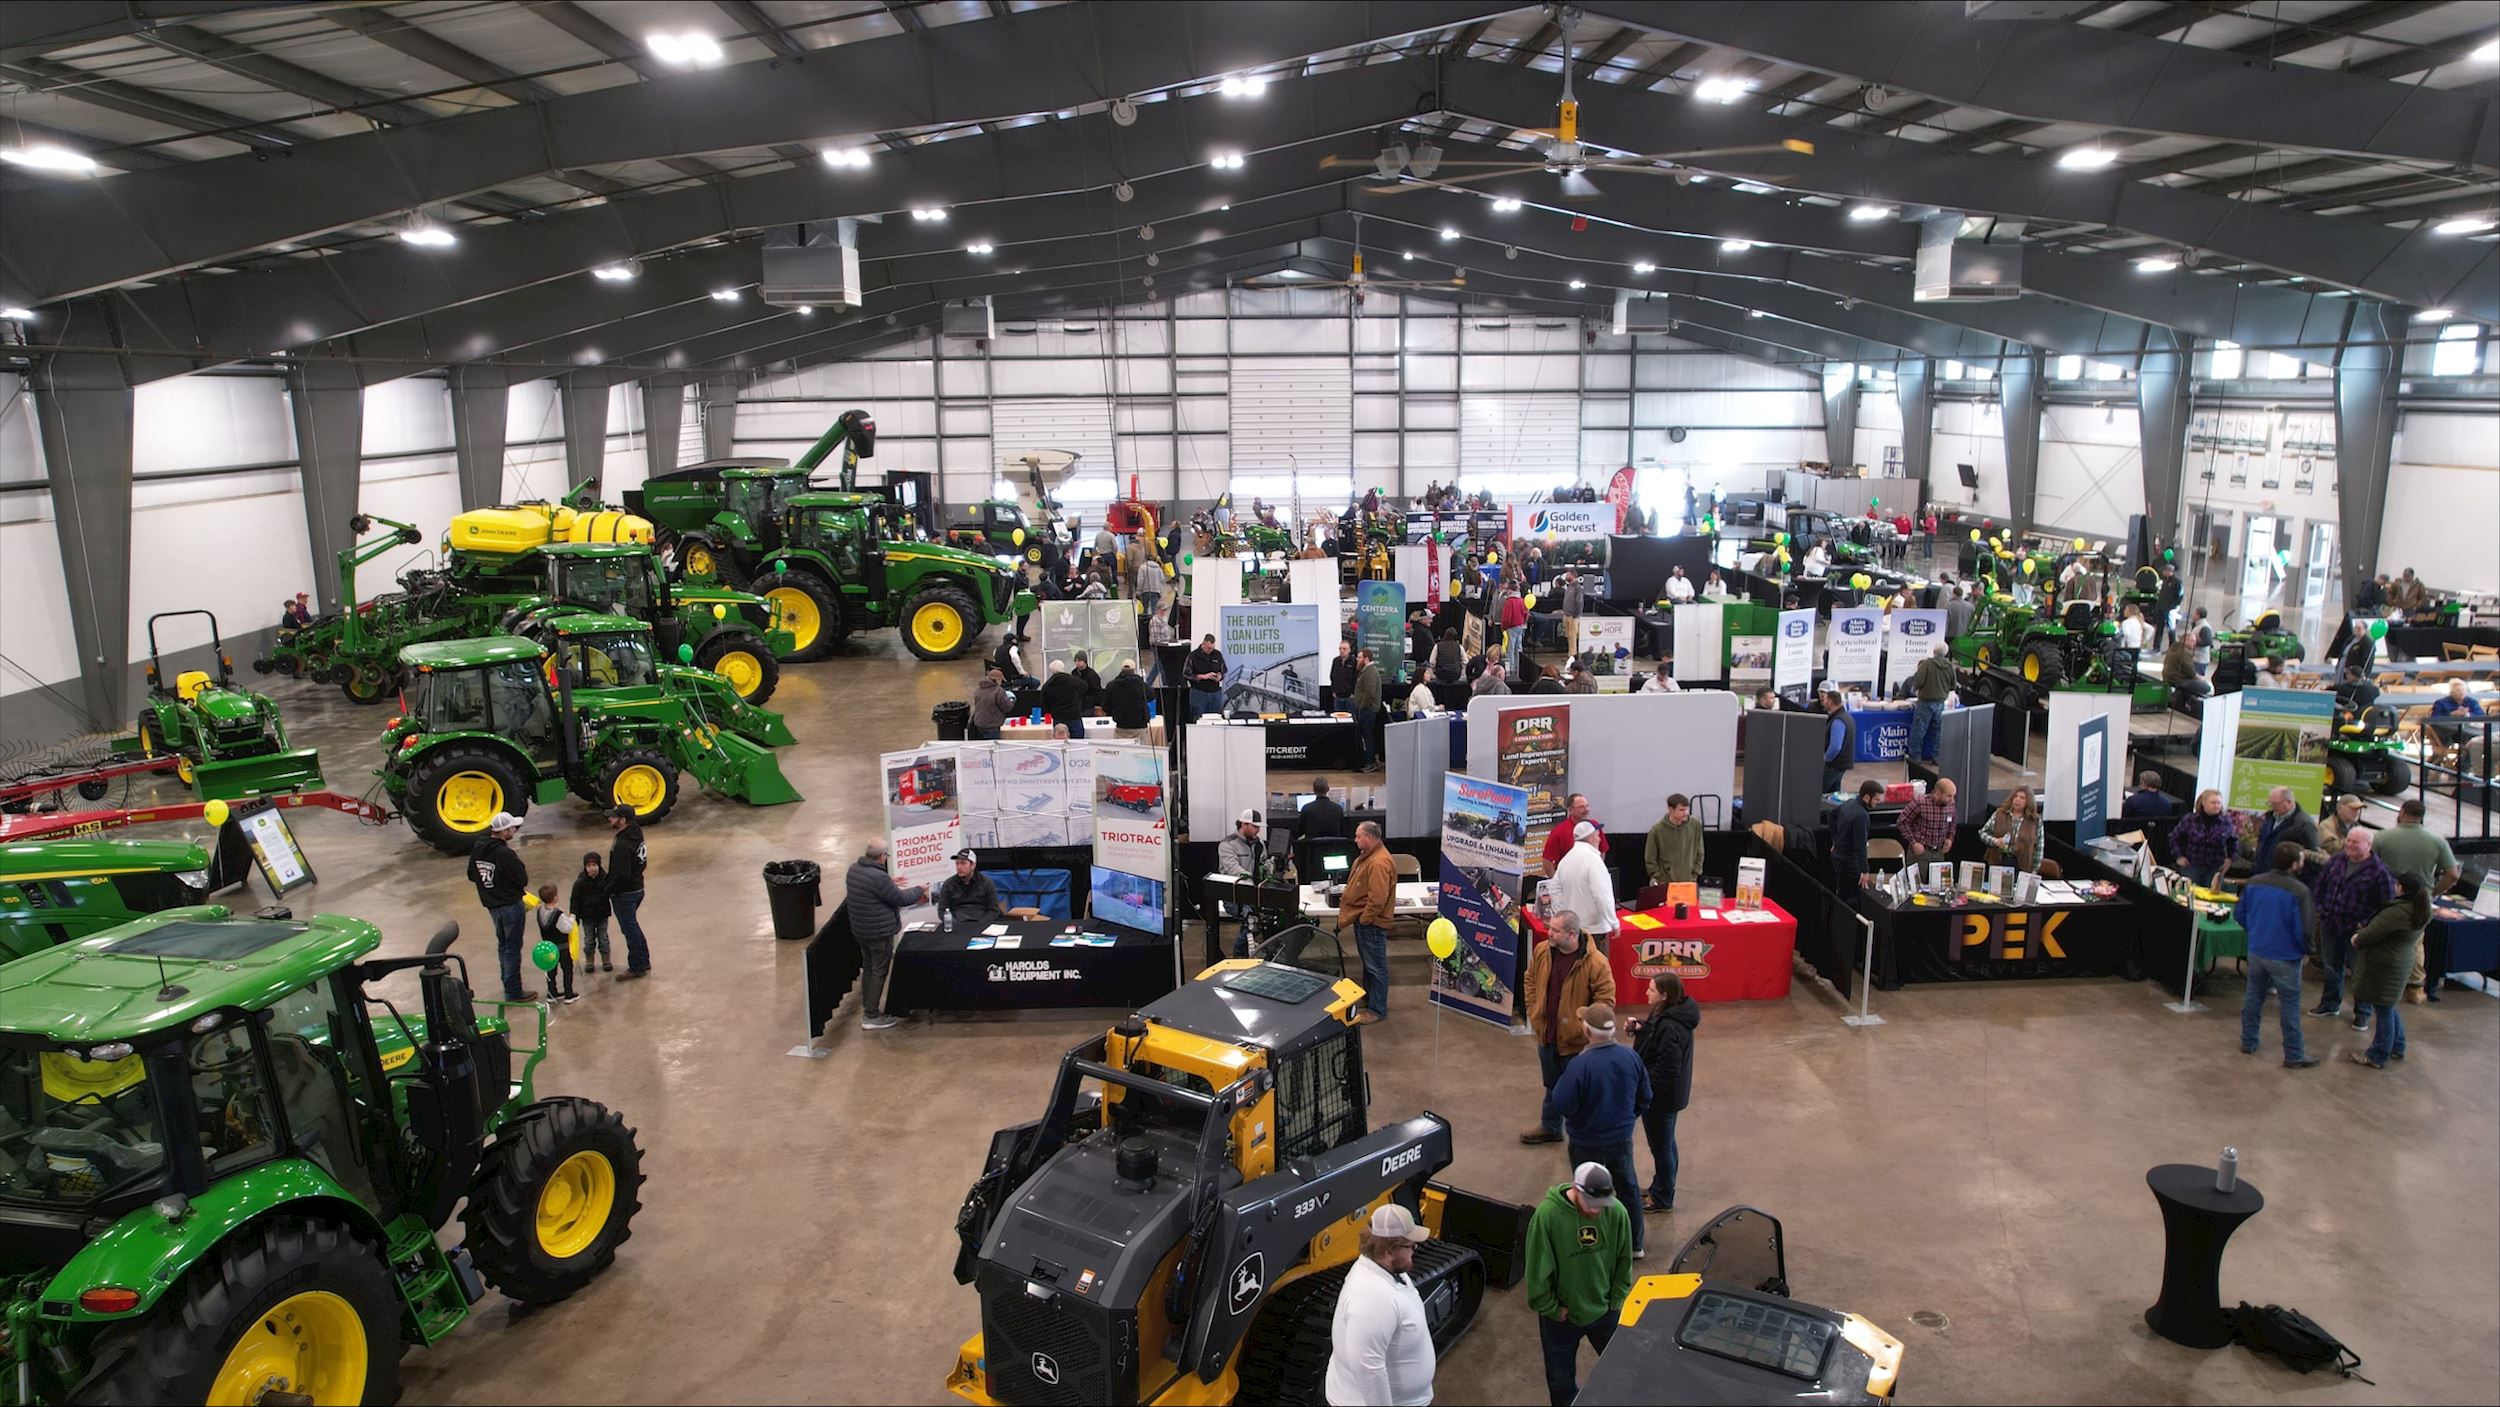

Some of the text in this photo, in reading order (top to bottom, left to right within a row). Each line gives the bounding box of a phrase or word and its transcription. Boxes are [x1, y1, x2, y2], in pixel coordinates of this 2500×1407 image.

[1550, 512, 1590, 521] Golden
[1550, 523, 1596, 532] Harvest
[1361, 604, 1398, 613] CENTERRA
[1226, 616, 1244, 626] THE
[1247, 616, 1276, 626] RIGHT
[1227, 629, 1280, 640] LOAN LIFTS
[1604, 626, 1623, 634] HOPE
[1227, 642, 1284, 654] YOU HIGHER
[1516, 716, 1552, 734] ORR
[1880, 726, 1908, 736] Main
[1878, 736, 1908, 748] Street
[1520, 749, 1565, 758] Improvement
[1880, 746, 1907, 758] Bank
[1521, 758, 1547, 766] Experts
[896, 830, 953, 848] TRIOMATIC
[1101, 832, 1161, 846] TRIOTRAC
[896, 842, 944, 858] ROBOTIC
[1446, 834, 1478, 848] UPGRADE
[1486, 844, 1518, 858] ENHANCE
[898, 853, 942, 869] FEEDING
[1948, 911, 2070, 960] PEK
[1641, 940, 1704, 964] ORR
[1005, 960, 1050, 971] HAROLDS
[1010, 970, 1082, 981] EQUIPMENT INC.
[1381, 1144, 1422, 1177] DEERE
